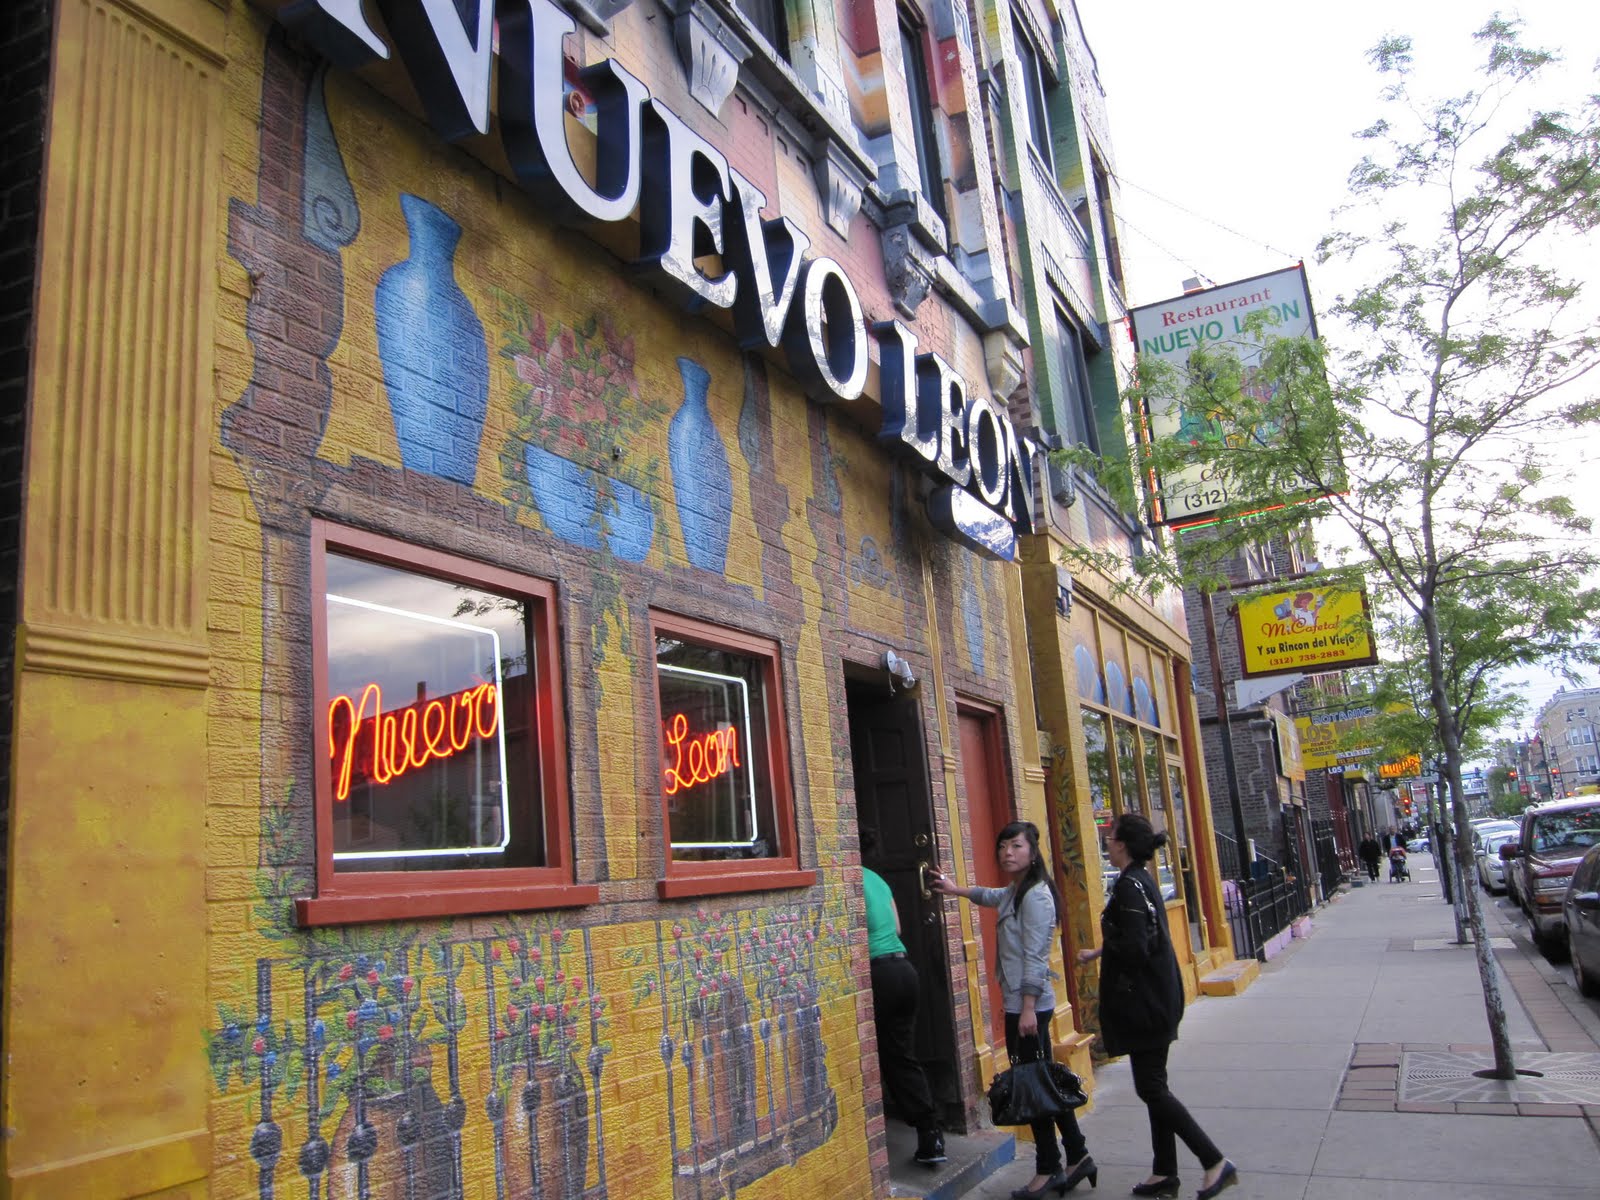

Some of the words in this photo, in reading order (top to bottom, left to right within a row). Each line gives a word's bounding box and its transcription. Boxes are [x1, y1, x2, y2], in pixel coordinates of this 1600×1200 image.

[1161, 287, 1272, 327] Restaurant
[1143, 320, 1223, 357] NUEVO
[1233, 299, 1300, 334] LON
[886, 319, 1036, 535] LEON
[1184, 487, 1228, 510] (312)
[1261, 622, 1290, 638] Mi
[1291, 615, 1340, 634] Cafetal
[1257, 646, 1263, 655] Y
[1266, 646, 1276, 655] su
[1279, 641, 1310, 653] Rincon
[1312, 636, 1327, 648] del
[1329, 633, 1355, 646] Viejo
[1269, 657, 1293, 666] (312)
[1299, 649, 1345, 662] 738-2883
[1311, 706, 1378, 725] BOTANIC
[328, 683, 499, 801] Nuevo
[1296, 724, 1333, 744] LOS
[664, 713, 741, 795] Leon
